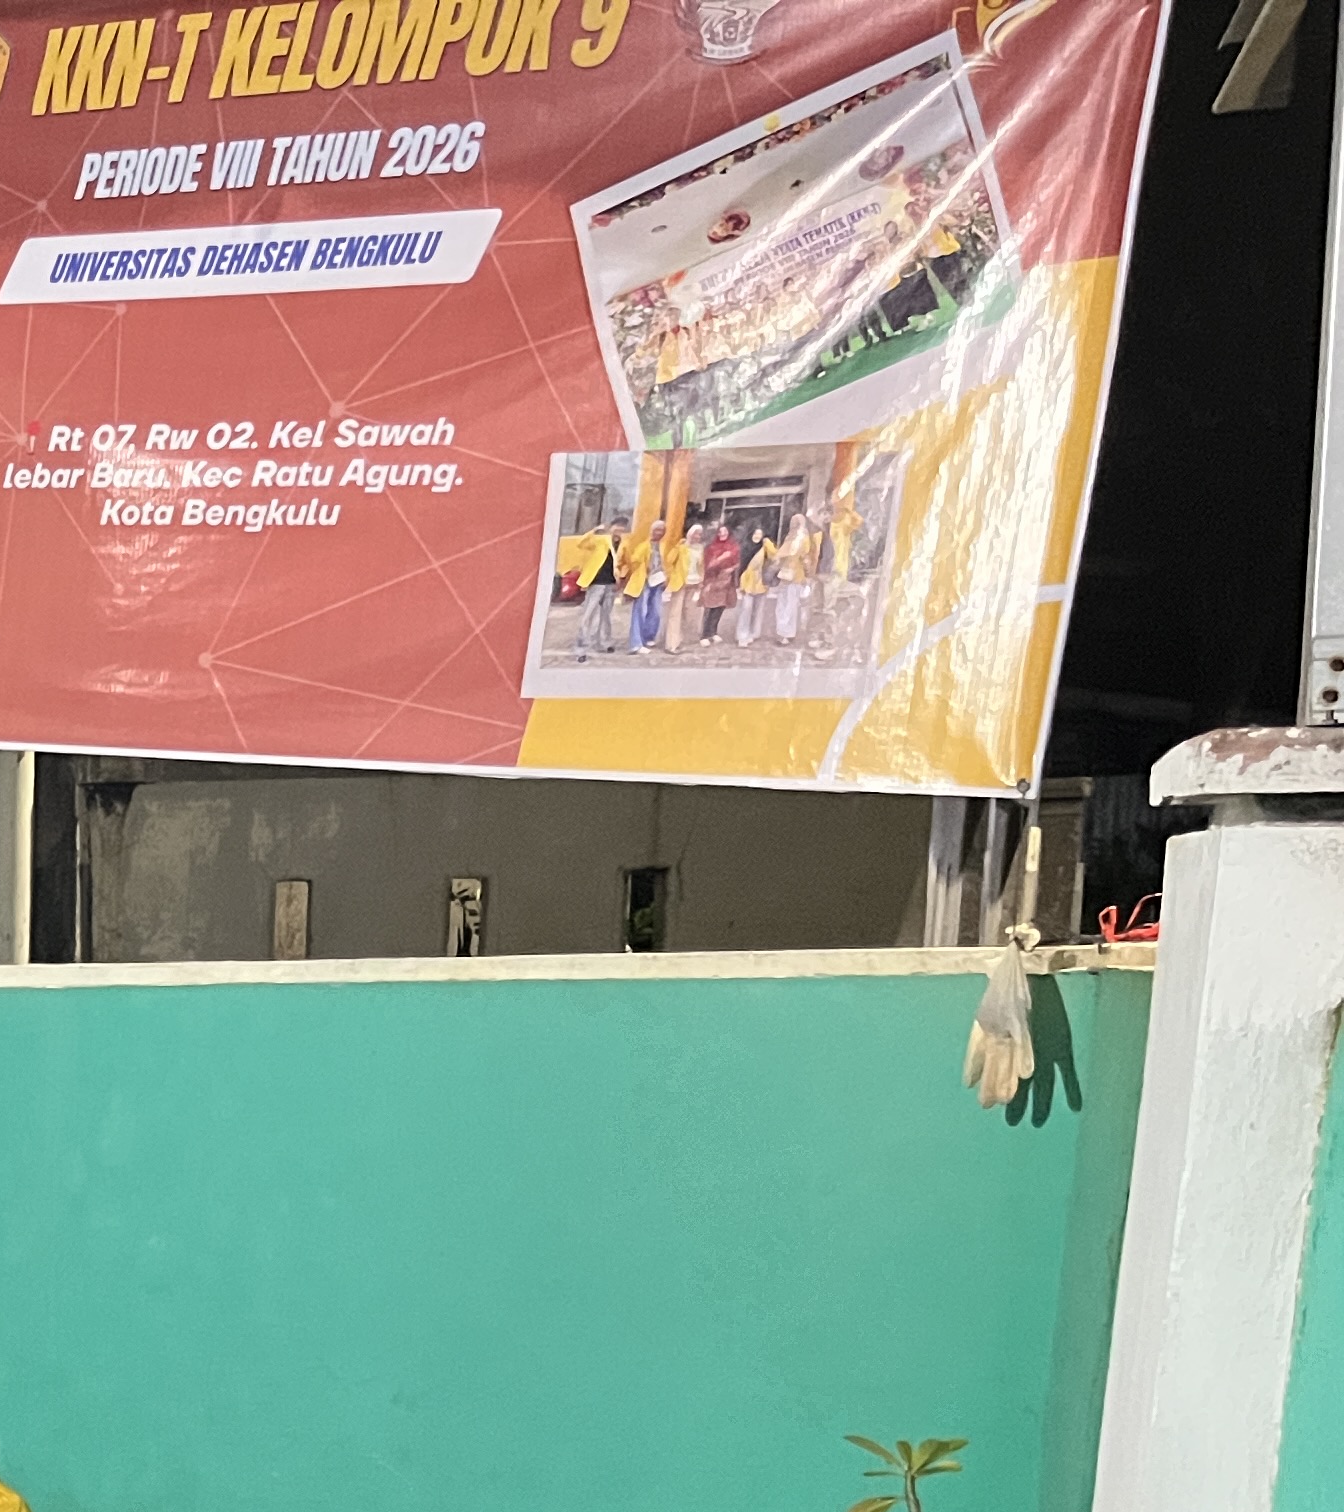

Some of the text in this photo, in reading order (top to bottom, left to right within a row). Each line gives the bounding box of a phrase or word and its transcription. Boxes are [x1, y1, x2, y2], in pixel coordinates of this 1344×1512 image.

[31, 0, 631, 116] KKN-T KELOMPOK 9
[74, 121, 486, 200] PERIODE VIII TAHUN 2026
[49, 230, 443, 284] UNIVERSITAS DEHASEN BENGKULU
[47, 425, 85, 452] Rt
[145, 424, 199, 452] Rw
[269, 419, 327, 449] Kel
[333, 417, 455, 448] Sawah
[3, 463, 85, 489] lebar
[182, 460, 243, 489] Kec
[251, 460, 333, 488] Ratu
[100, 498, 341, 533] Kota Bengkulu
